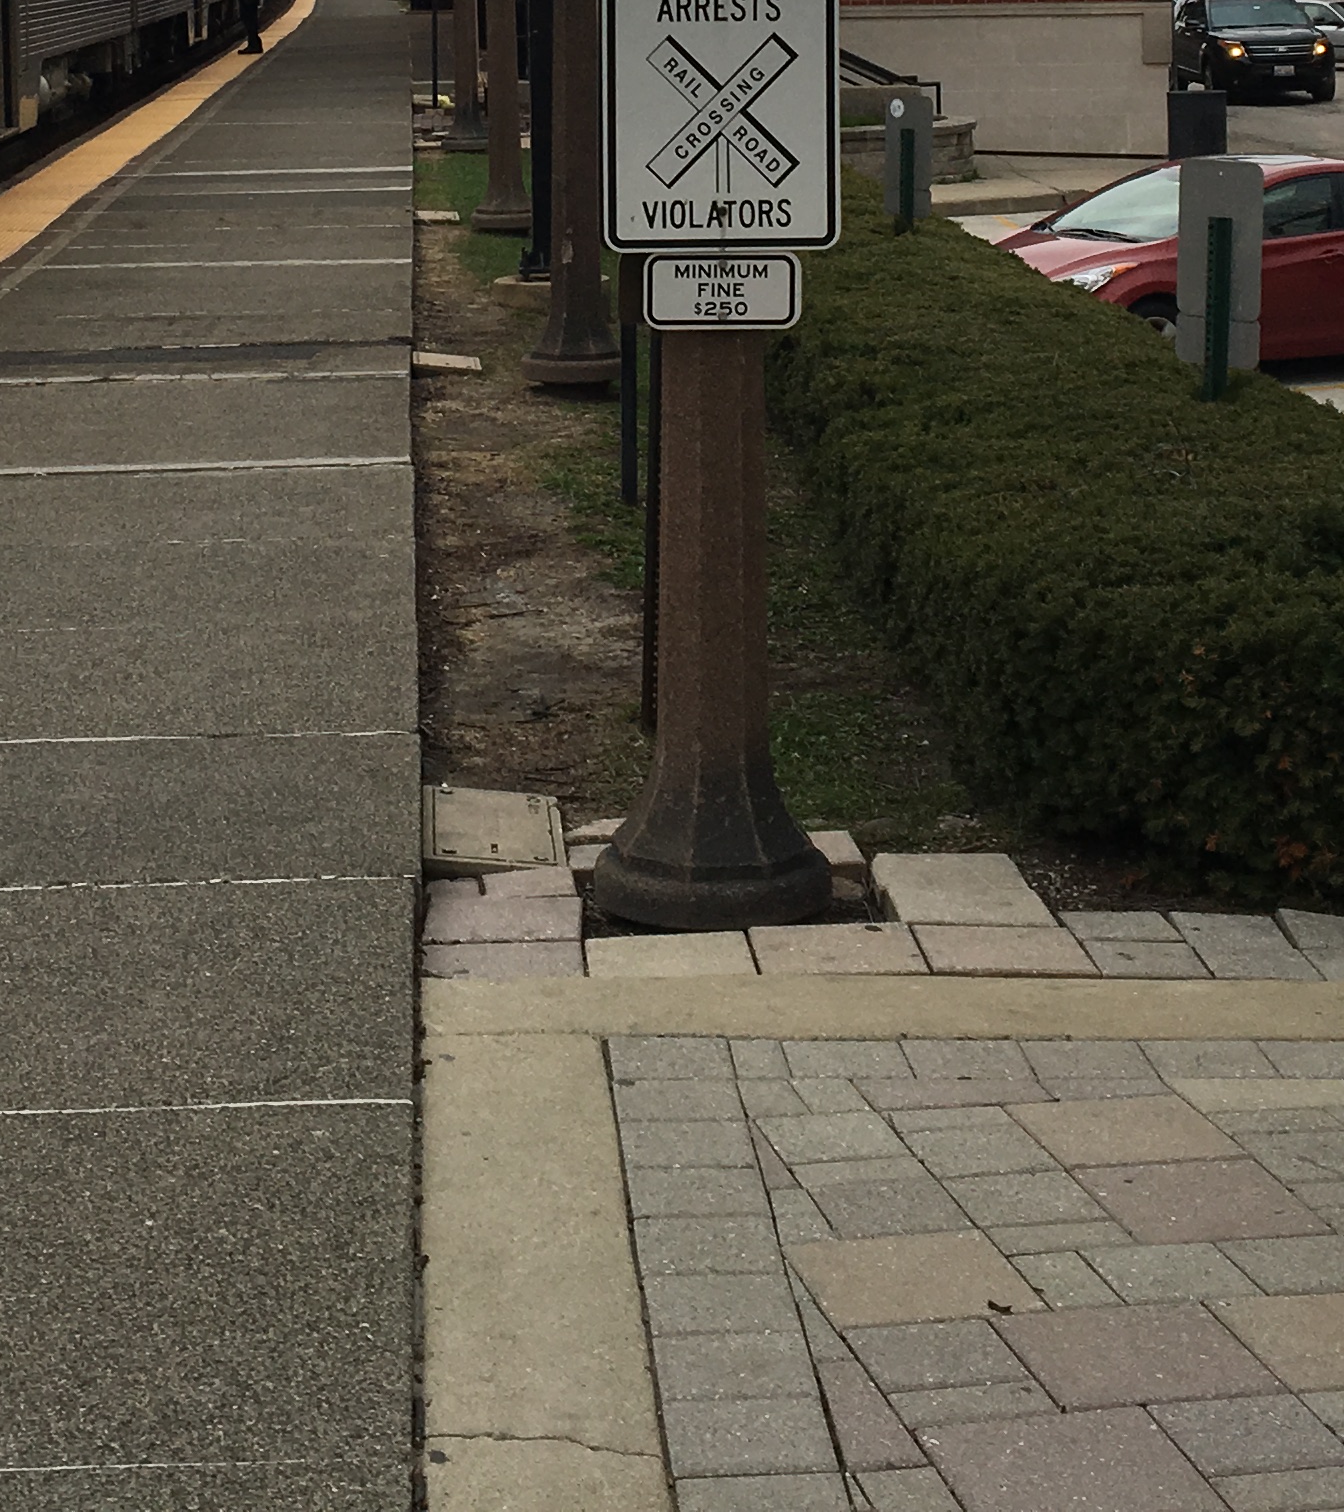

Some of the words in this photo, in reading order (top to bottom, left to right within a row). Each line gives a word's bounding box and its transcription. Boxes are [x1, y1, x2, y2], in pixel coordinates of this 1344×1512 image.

[662, 56, 706, 99] RAIL
[673, 67, 766, 160] CROSSING
[732, 125, 781, 174] ROAD
[641, 198, 792, 230] VIOLATORS
[674, 263, 769, 279] MINIMUM
[697, 282, 745, 298] FINE
[693, 301, 749, 317] $250
